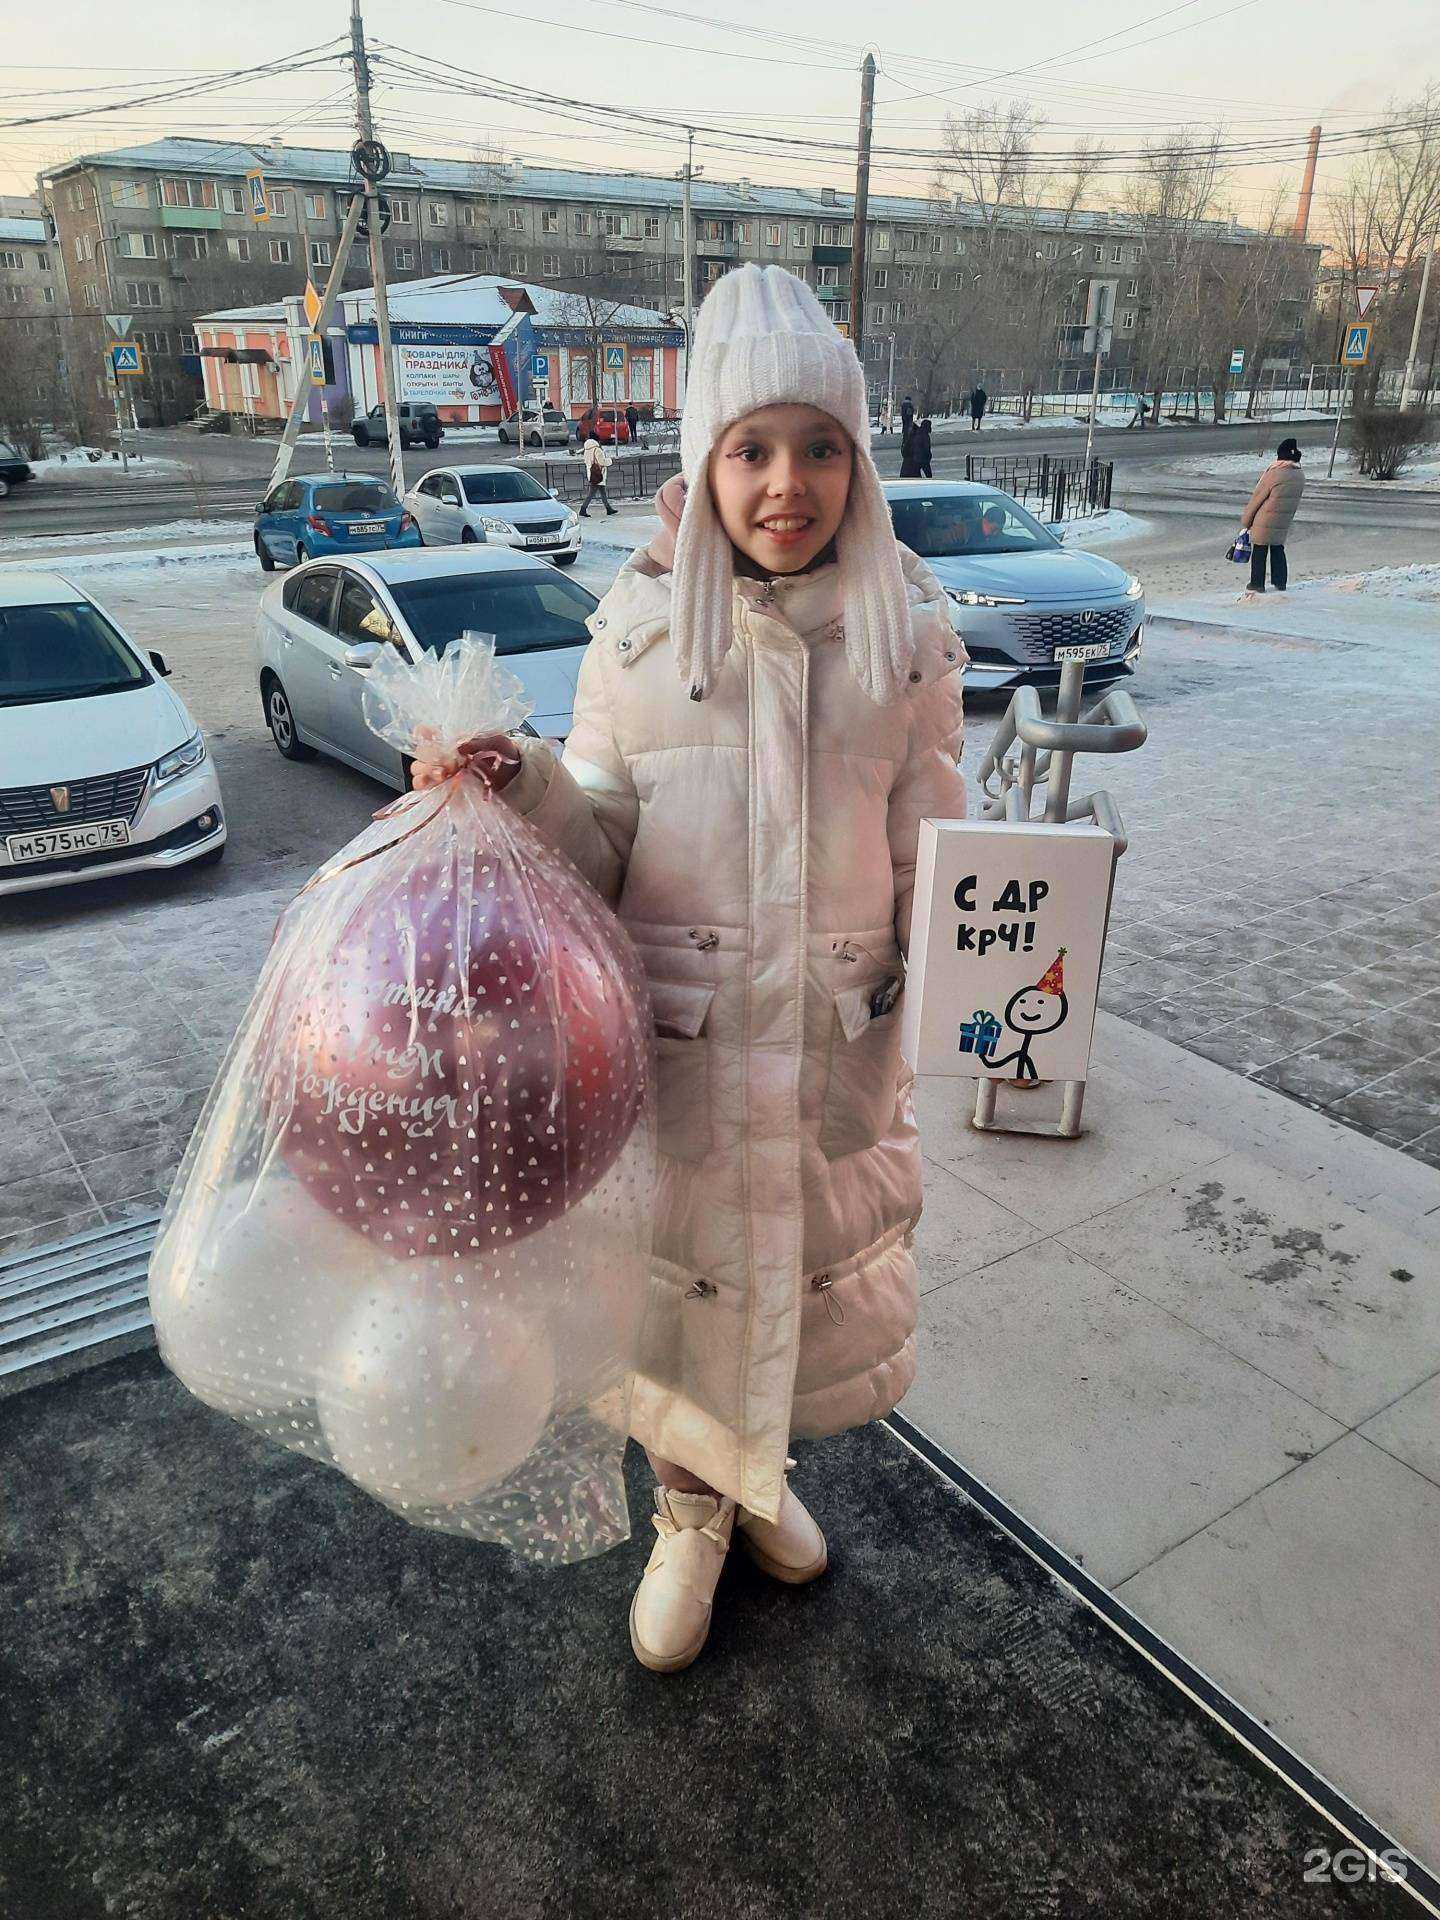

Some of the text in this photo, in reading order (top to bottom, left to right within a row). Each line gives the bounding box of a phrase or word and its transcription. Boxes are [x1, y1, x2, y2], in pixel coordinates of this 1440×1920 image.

[400, 329, 427, 340] КНИГИ
[406, 350, 466, 360] ТОВАРЫ ДЛЯ
[405, 360, 468, 370] ПРАЗДНИКА
[19, 832, 98, 857] М575НС
[953, 874, 1050, 913] С ДР
